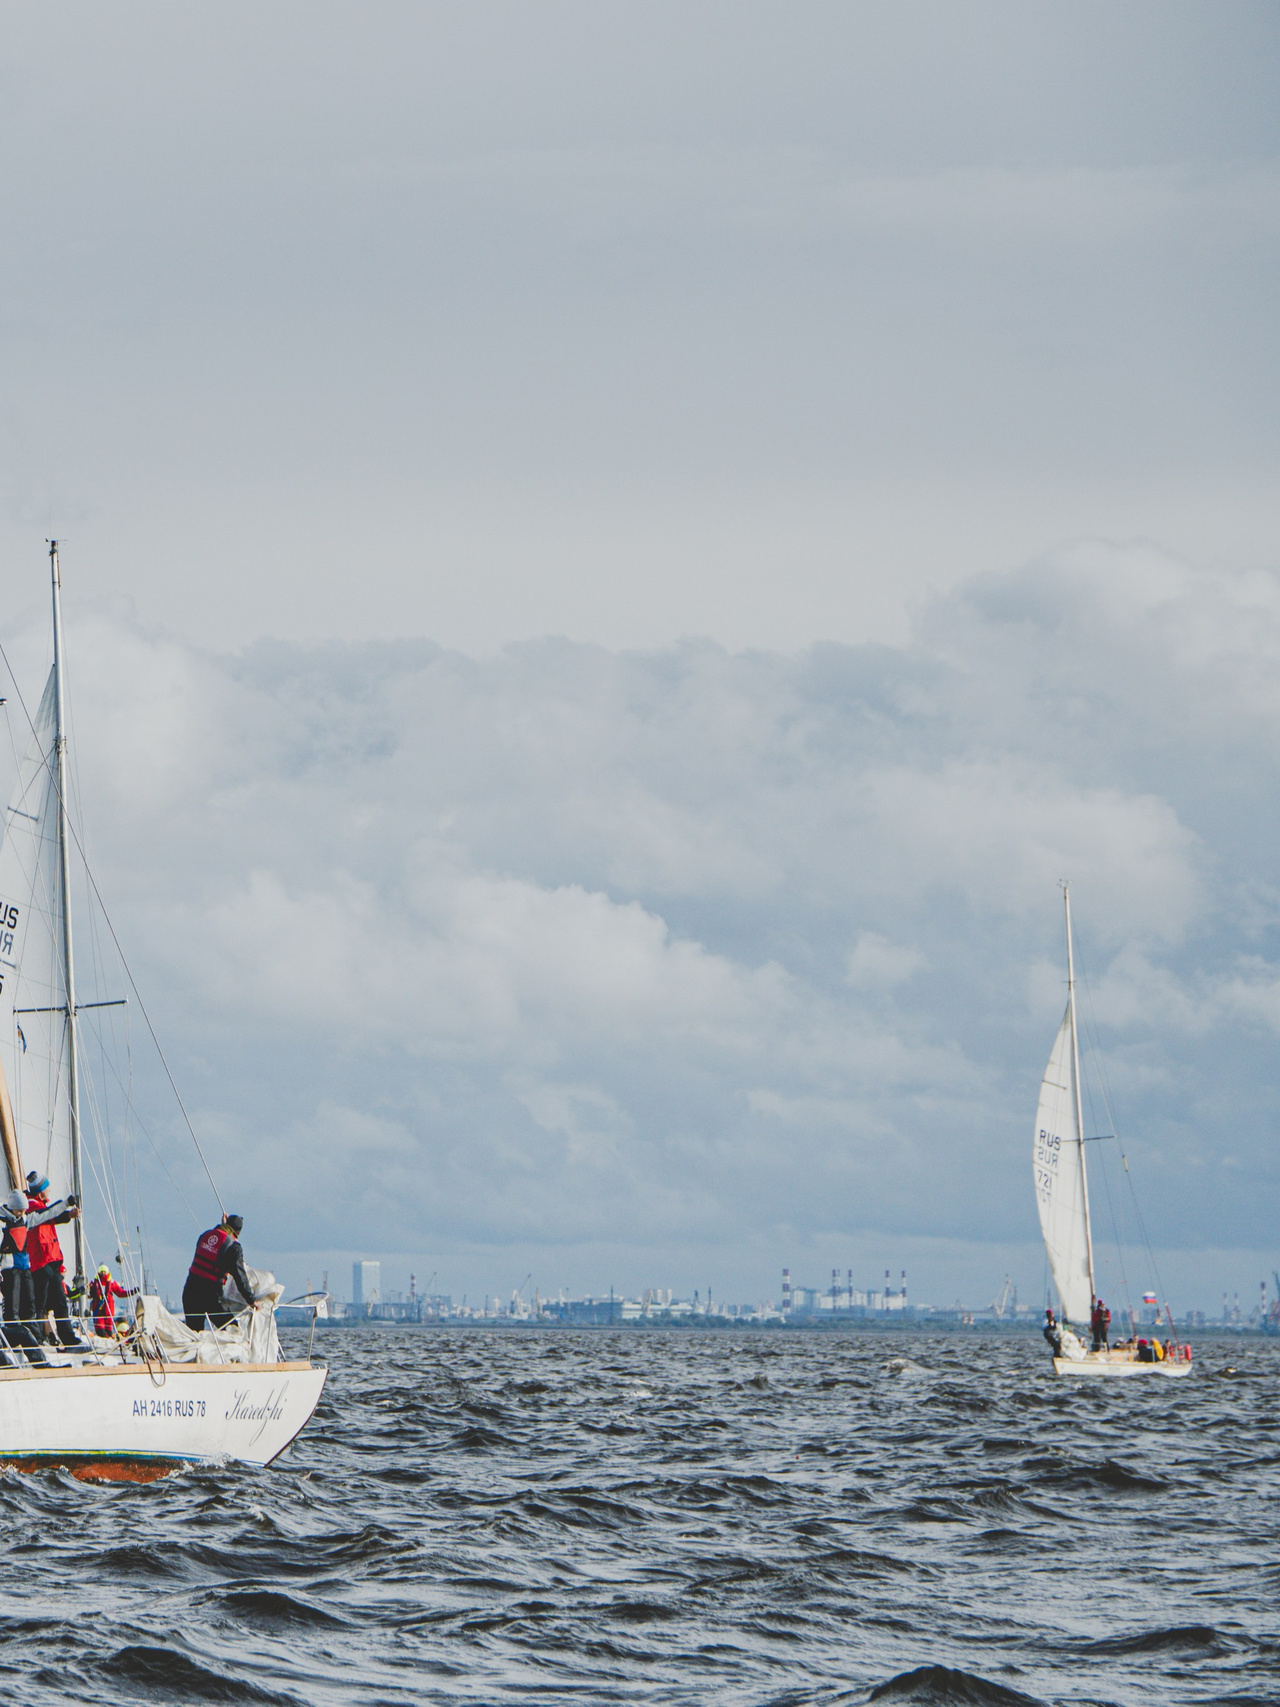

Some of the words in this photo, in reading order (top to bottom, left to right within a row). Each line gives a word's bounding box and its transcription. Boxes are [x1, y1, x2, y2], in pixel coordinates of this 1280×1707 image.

[1039, 1129, 1061, 1151] RUS
[132, 1400, 148, 1417] AH
[150, 1400, 172, 1417] 2416
[175, 1400, 194, 1417] RUS
[196, 1401, 206, 1418] 78
